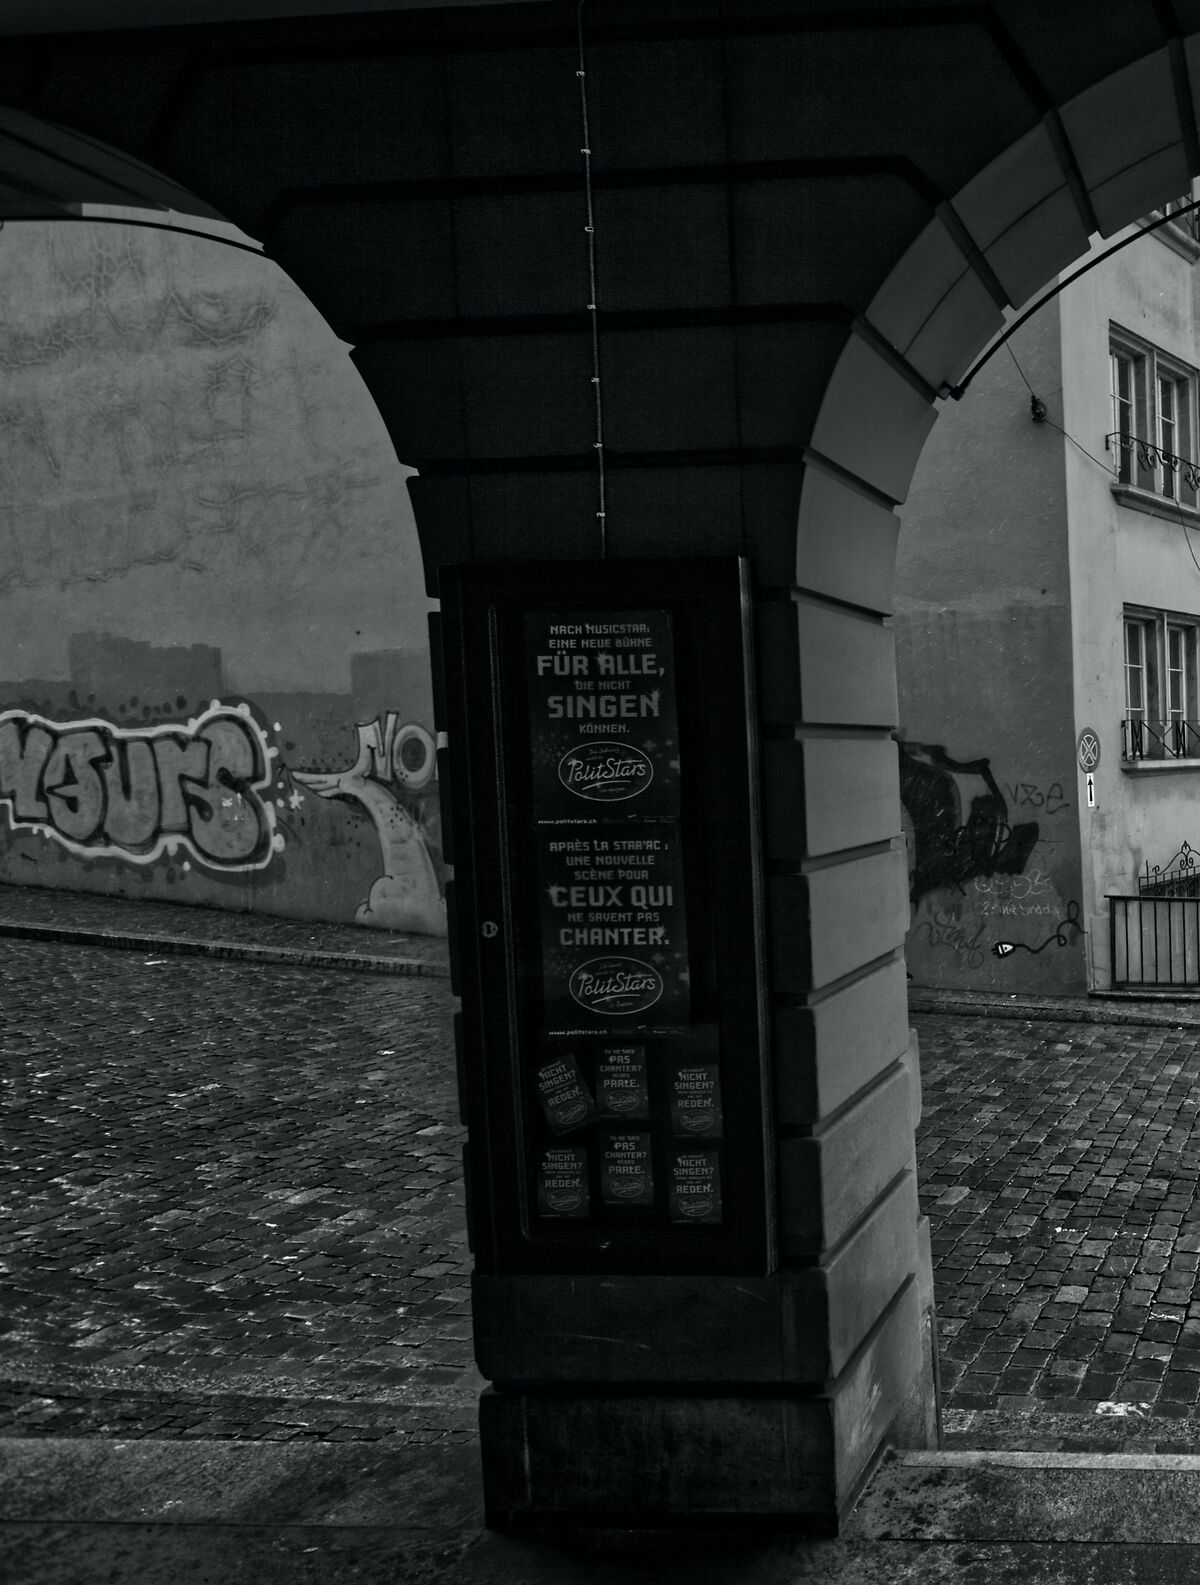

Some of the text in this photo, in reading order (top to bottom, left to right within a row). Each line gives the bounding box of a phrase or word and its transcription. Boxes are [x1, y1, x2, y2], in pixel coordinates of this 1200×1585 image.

[550, 625, 582, 635] NACH
[549, 636, 652, 648] EINE NEUE BÜHNE
[537, 650, 665, 678] FÜR ALLE,
[575, 680, 631, 690] DIE NICHT
[548, 693, 660, 718] SINGEN
[579, 723, 631, 734] KÖNNEN.
[567, 757, 646, 783] PolitStars
[549, 838, 590, 852] APRÈS
[593, 840, 609, 851] LA
[613, 840, 660, 850] STAR'AC
[566, 855, 655, 866] UNE NOUVELLE
[574, 868, 649, 880] SCÈNE POUR
[549, 884, 673, 910] CEUX QUI
[567, 912, 660, 922] NE SAVENT PAS
[560, 926, 670, 945] CHANTER.
[577, 972, 656, 997] PolitStars
[609, 1055, 630, 1064] PAS
[538, 1064, 567, 1080] NICHT
[678, 1072, 707, 1081] NICHT
[603, 1079, 640, 1088] PARLE.
[674, 1081, 714, 1090] SINGEN?
[677, 1098, 714, 1108] REDEN.
[614, 1142, 635, 1151] PAS
[546, 1152, 576, 1161] NICHT
[605, 1151, 647, 1159] CHANTER?
[541, 1162, 583, 1170] SINGEN?
[677, 1158, 707, 1167] NICHT
[609, 1165, 645, 1174] PARLE.
[673, 1167, 714, 1176] SINGEN?
[545, 1179, 582, 1188] REDEN.
[676, 1184, 714, 1194] REDEN.
